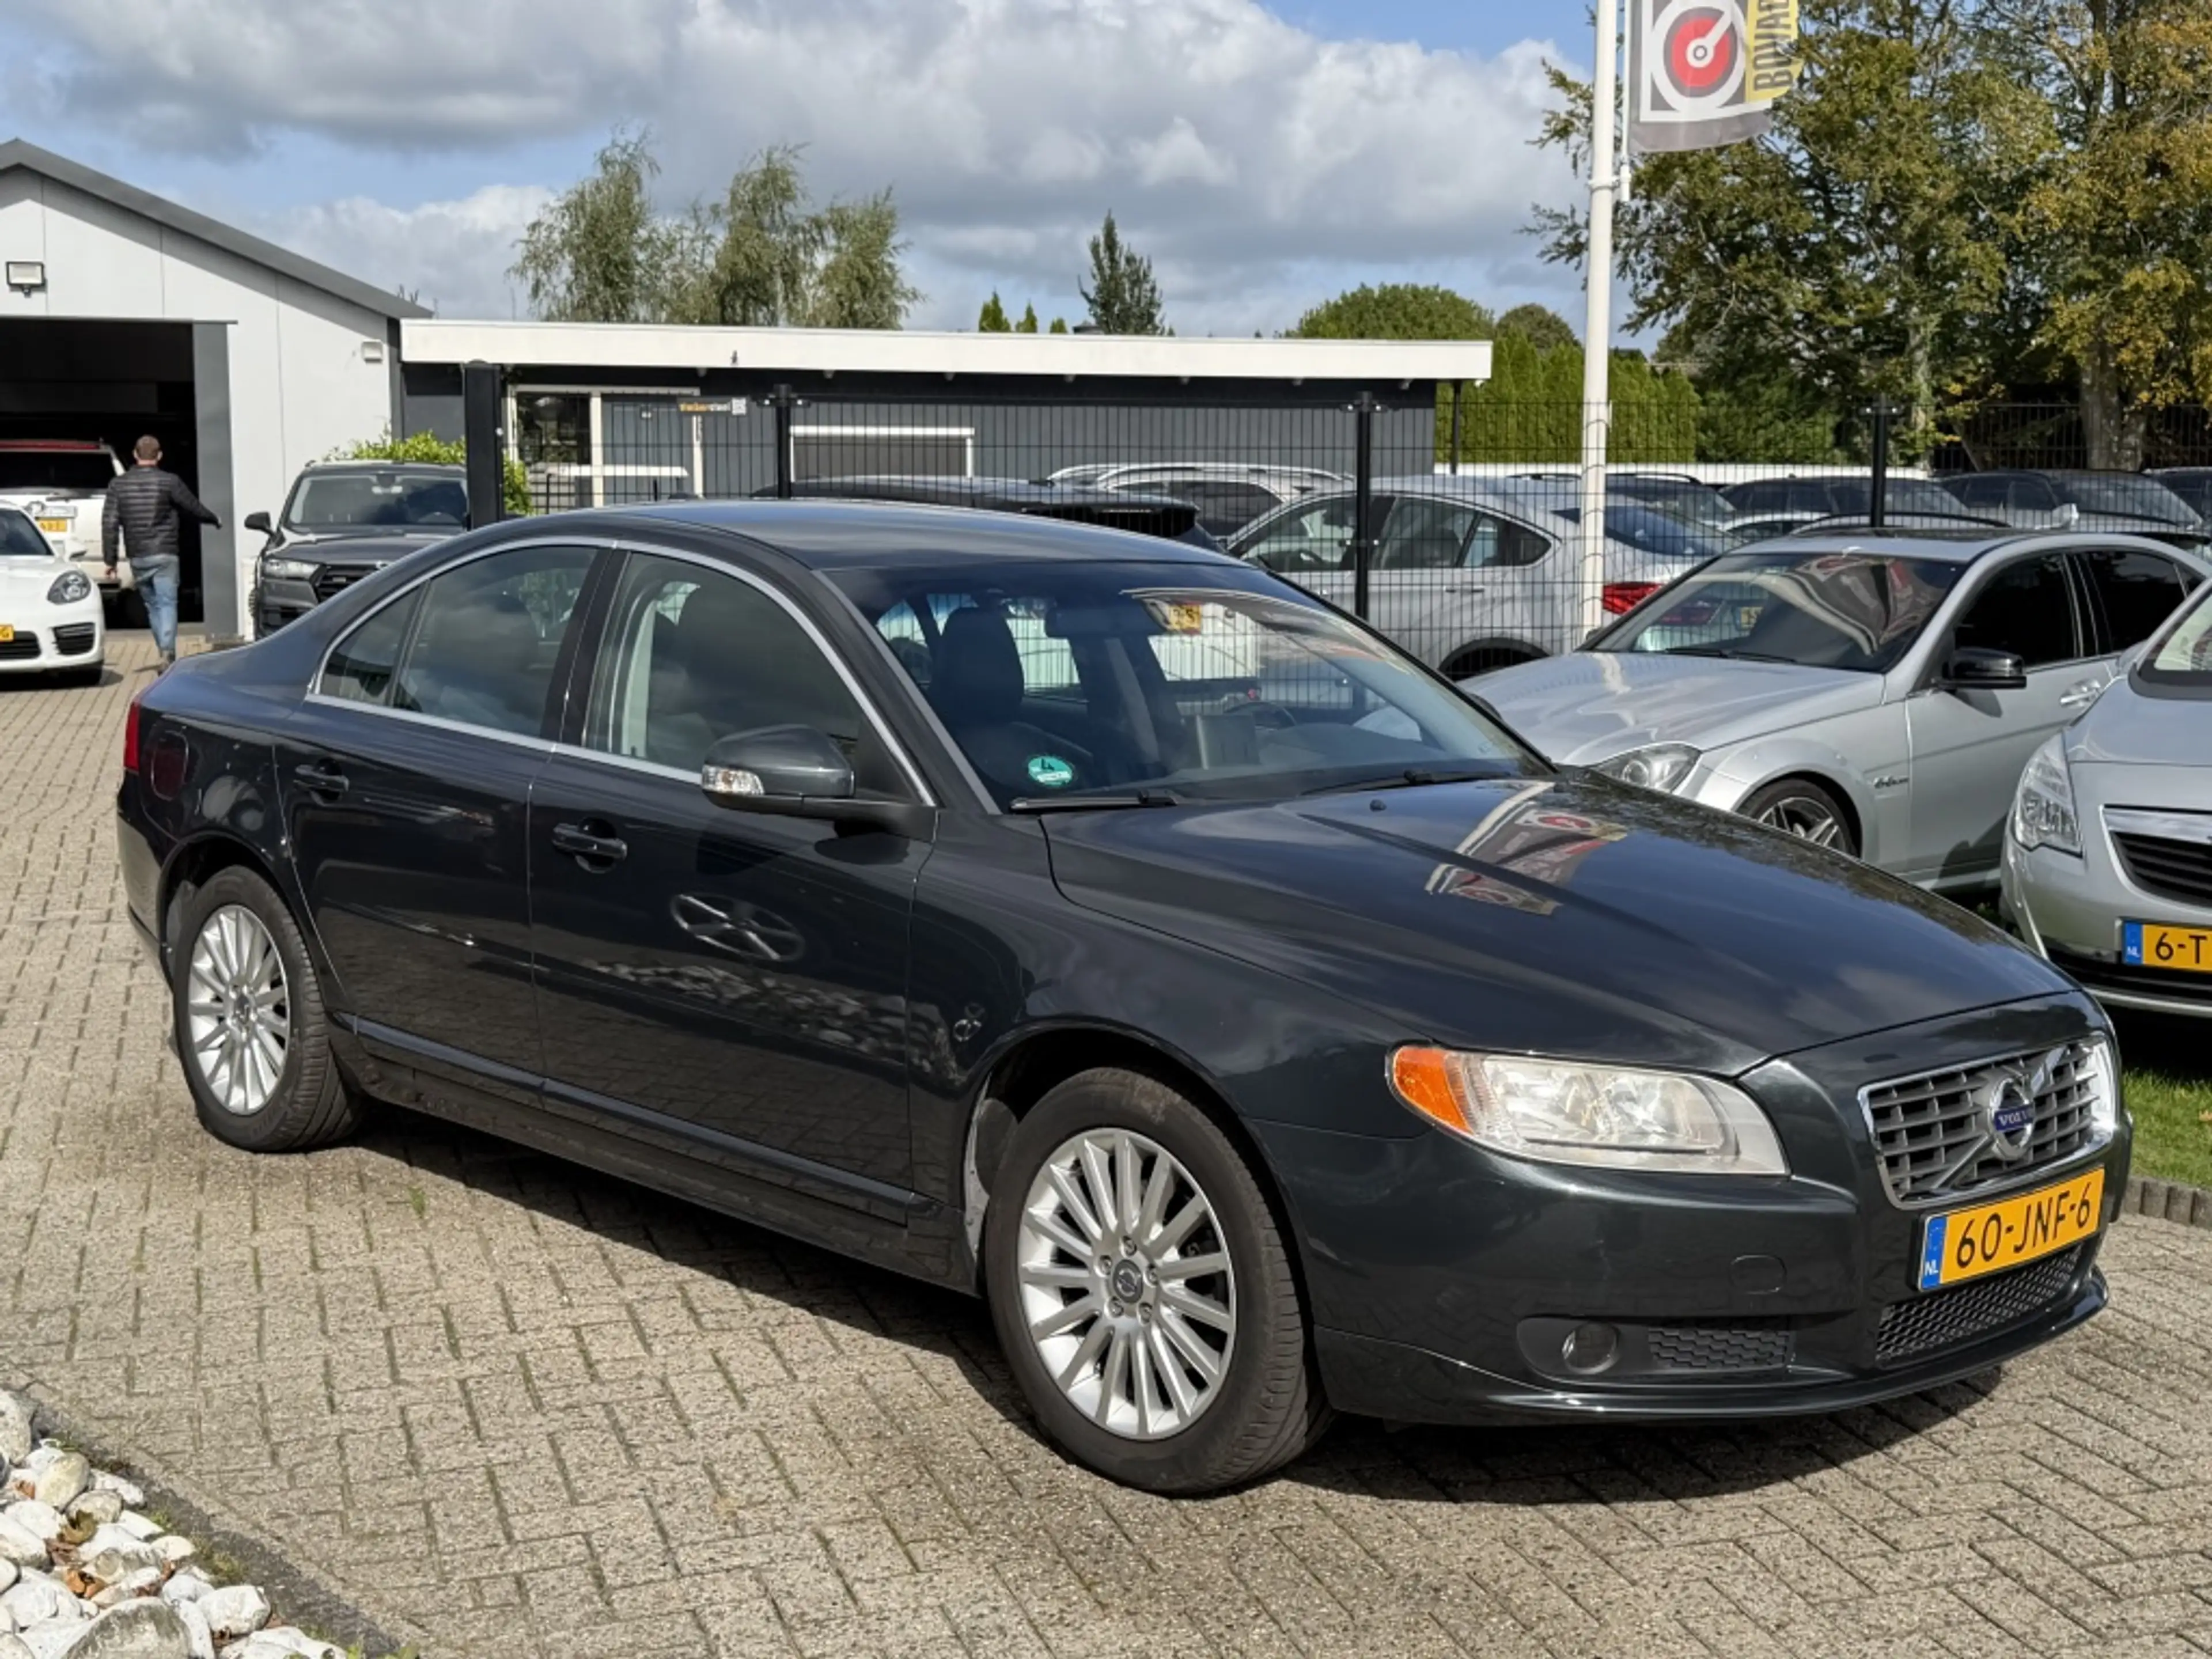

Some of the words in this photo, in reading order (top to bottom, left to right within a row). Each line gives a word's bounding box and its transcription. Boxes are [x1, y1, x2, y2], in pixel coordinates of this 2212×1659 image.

[2126, 945, 2141, 958] NL
[1998, 1108, 2034, 1127] VOLV
[1956, 1181, 2091, 1269] 60-JNF-6
[1925, 1259, 1939, 1277] NL
